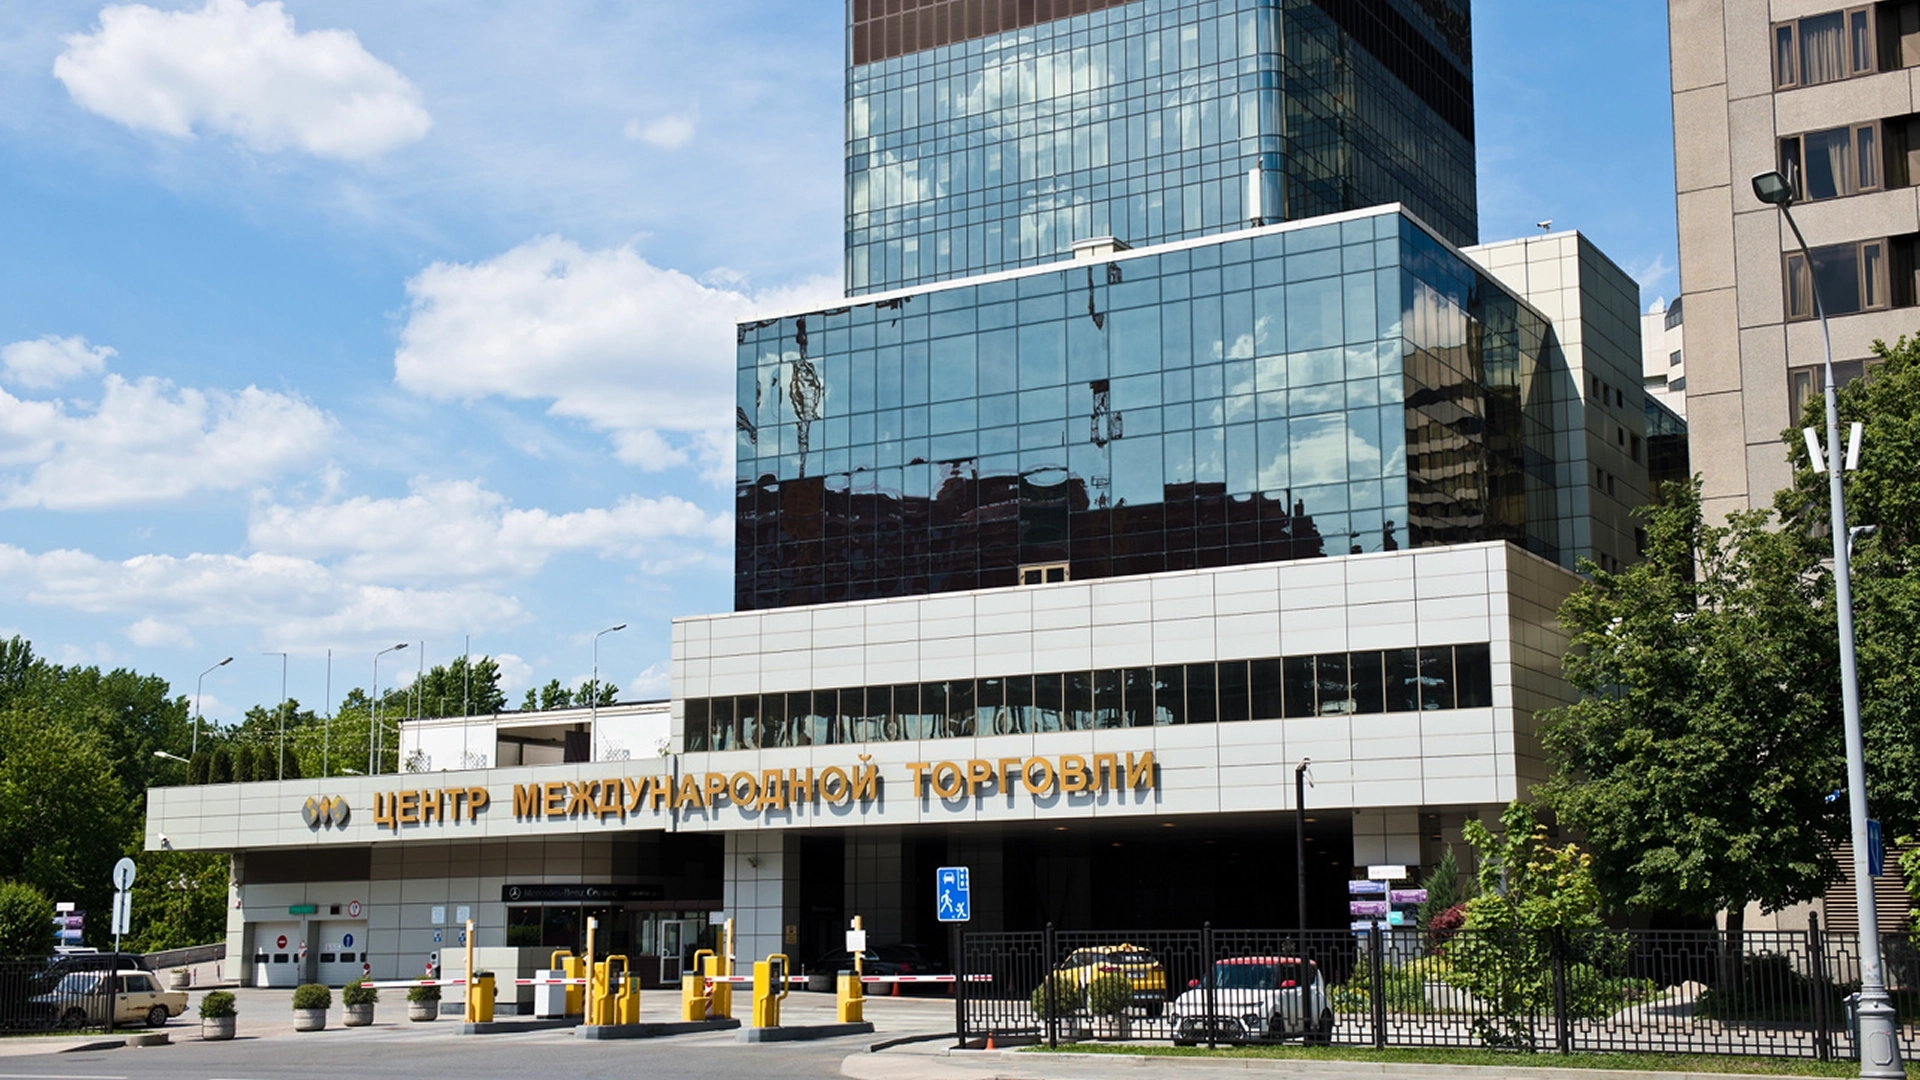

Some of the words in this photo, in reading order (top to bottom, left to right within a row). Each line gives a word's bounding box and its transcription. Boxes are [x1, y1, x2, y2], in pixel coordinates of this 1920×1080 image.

[373, 786, 488, 829] ЦЕНТР
[513, 754, 878, 819] МЕЖДУНАРОДНОЙ
[905, 751, 1155, 798] ТОРГОВЛИ
